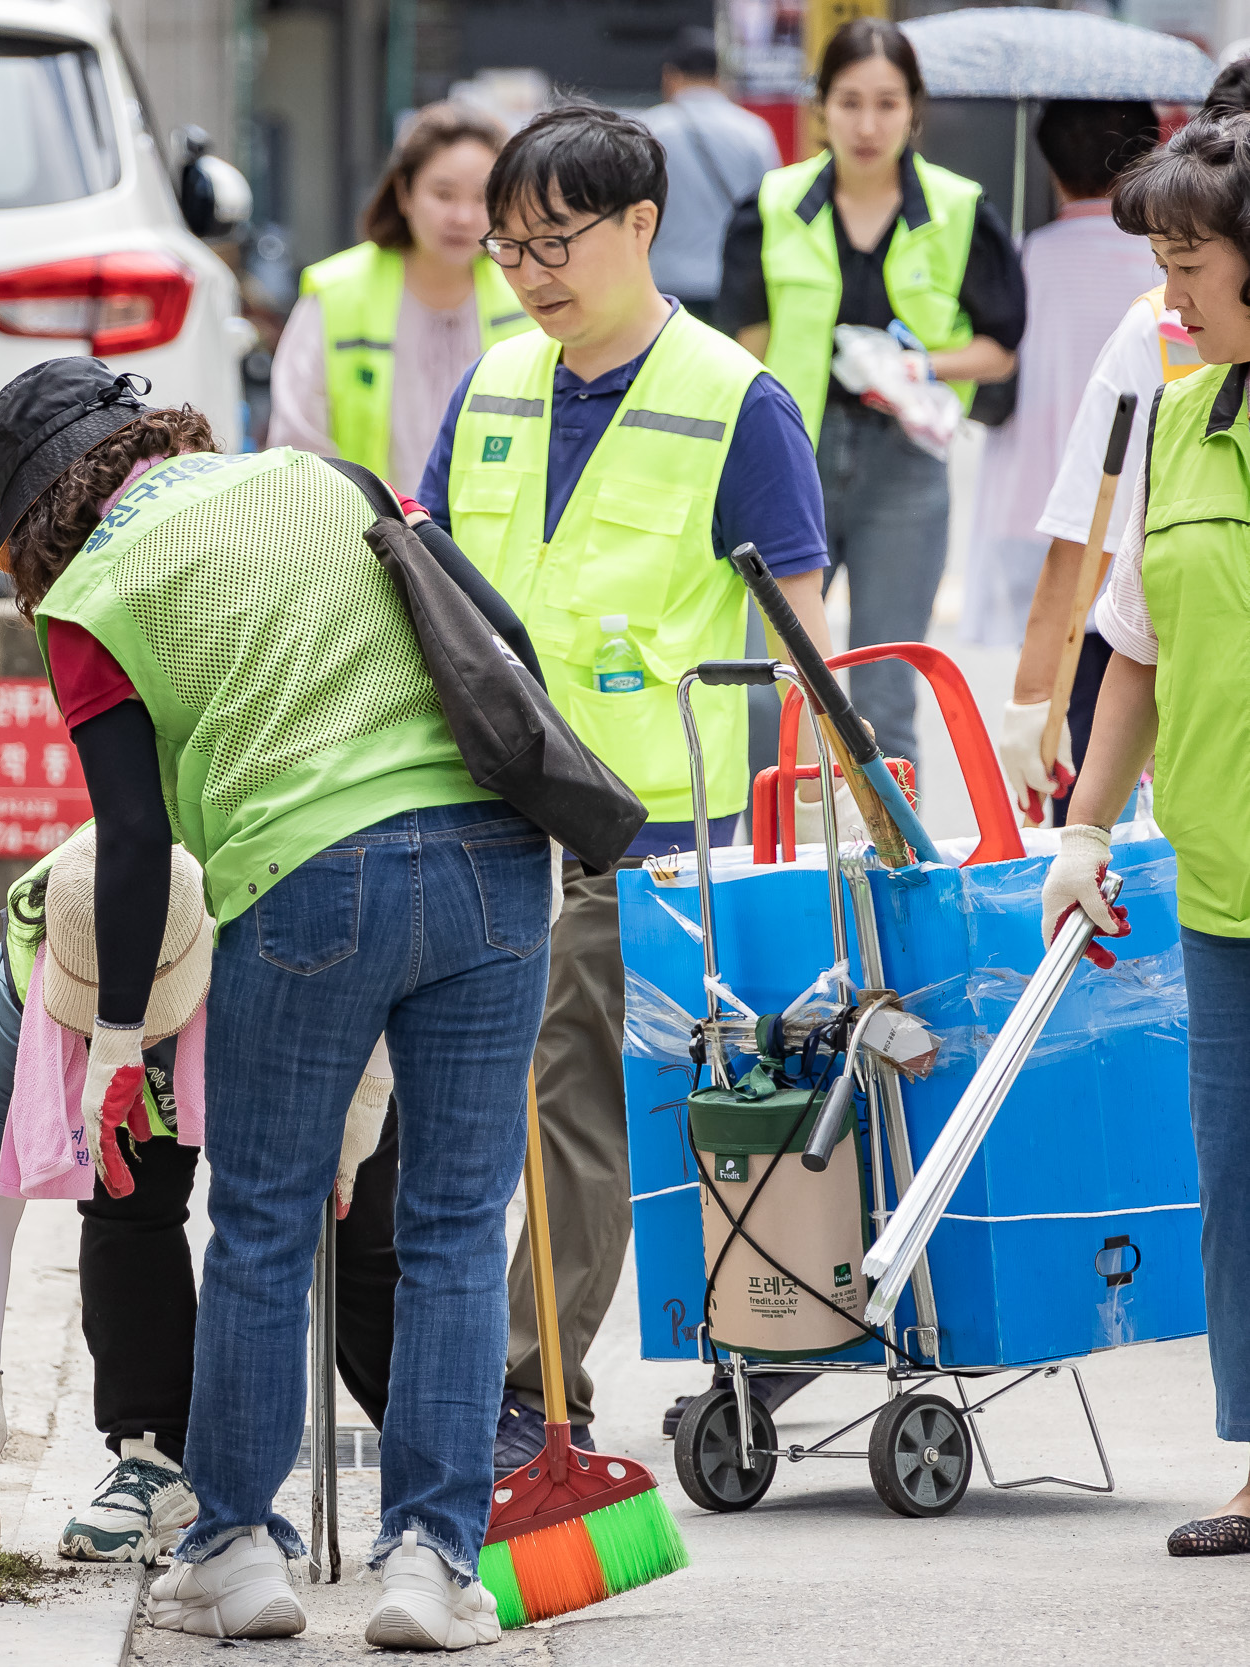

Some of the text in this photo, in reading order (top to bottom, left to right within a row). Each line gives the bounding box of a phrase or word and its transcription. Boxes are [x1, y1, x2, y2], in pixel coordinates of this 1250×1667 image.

[719, 1169, 740, 1180] Fredit
[835, 1273, 852, 1283] Fredit
[749, 1296, 799, 1306] fredit.co.kr
